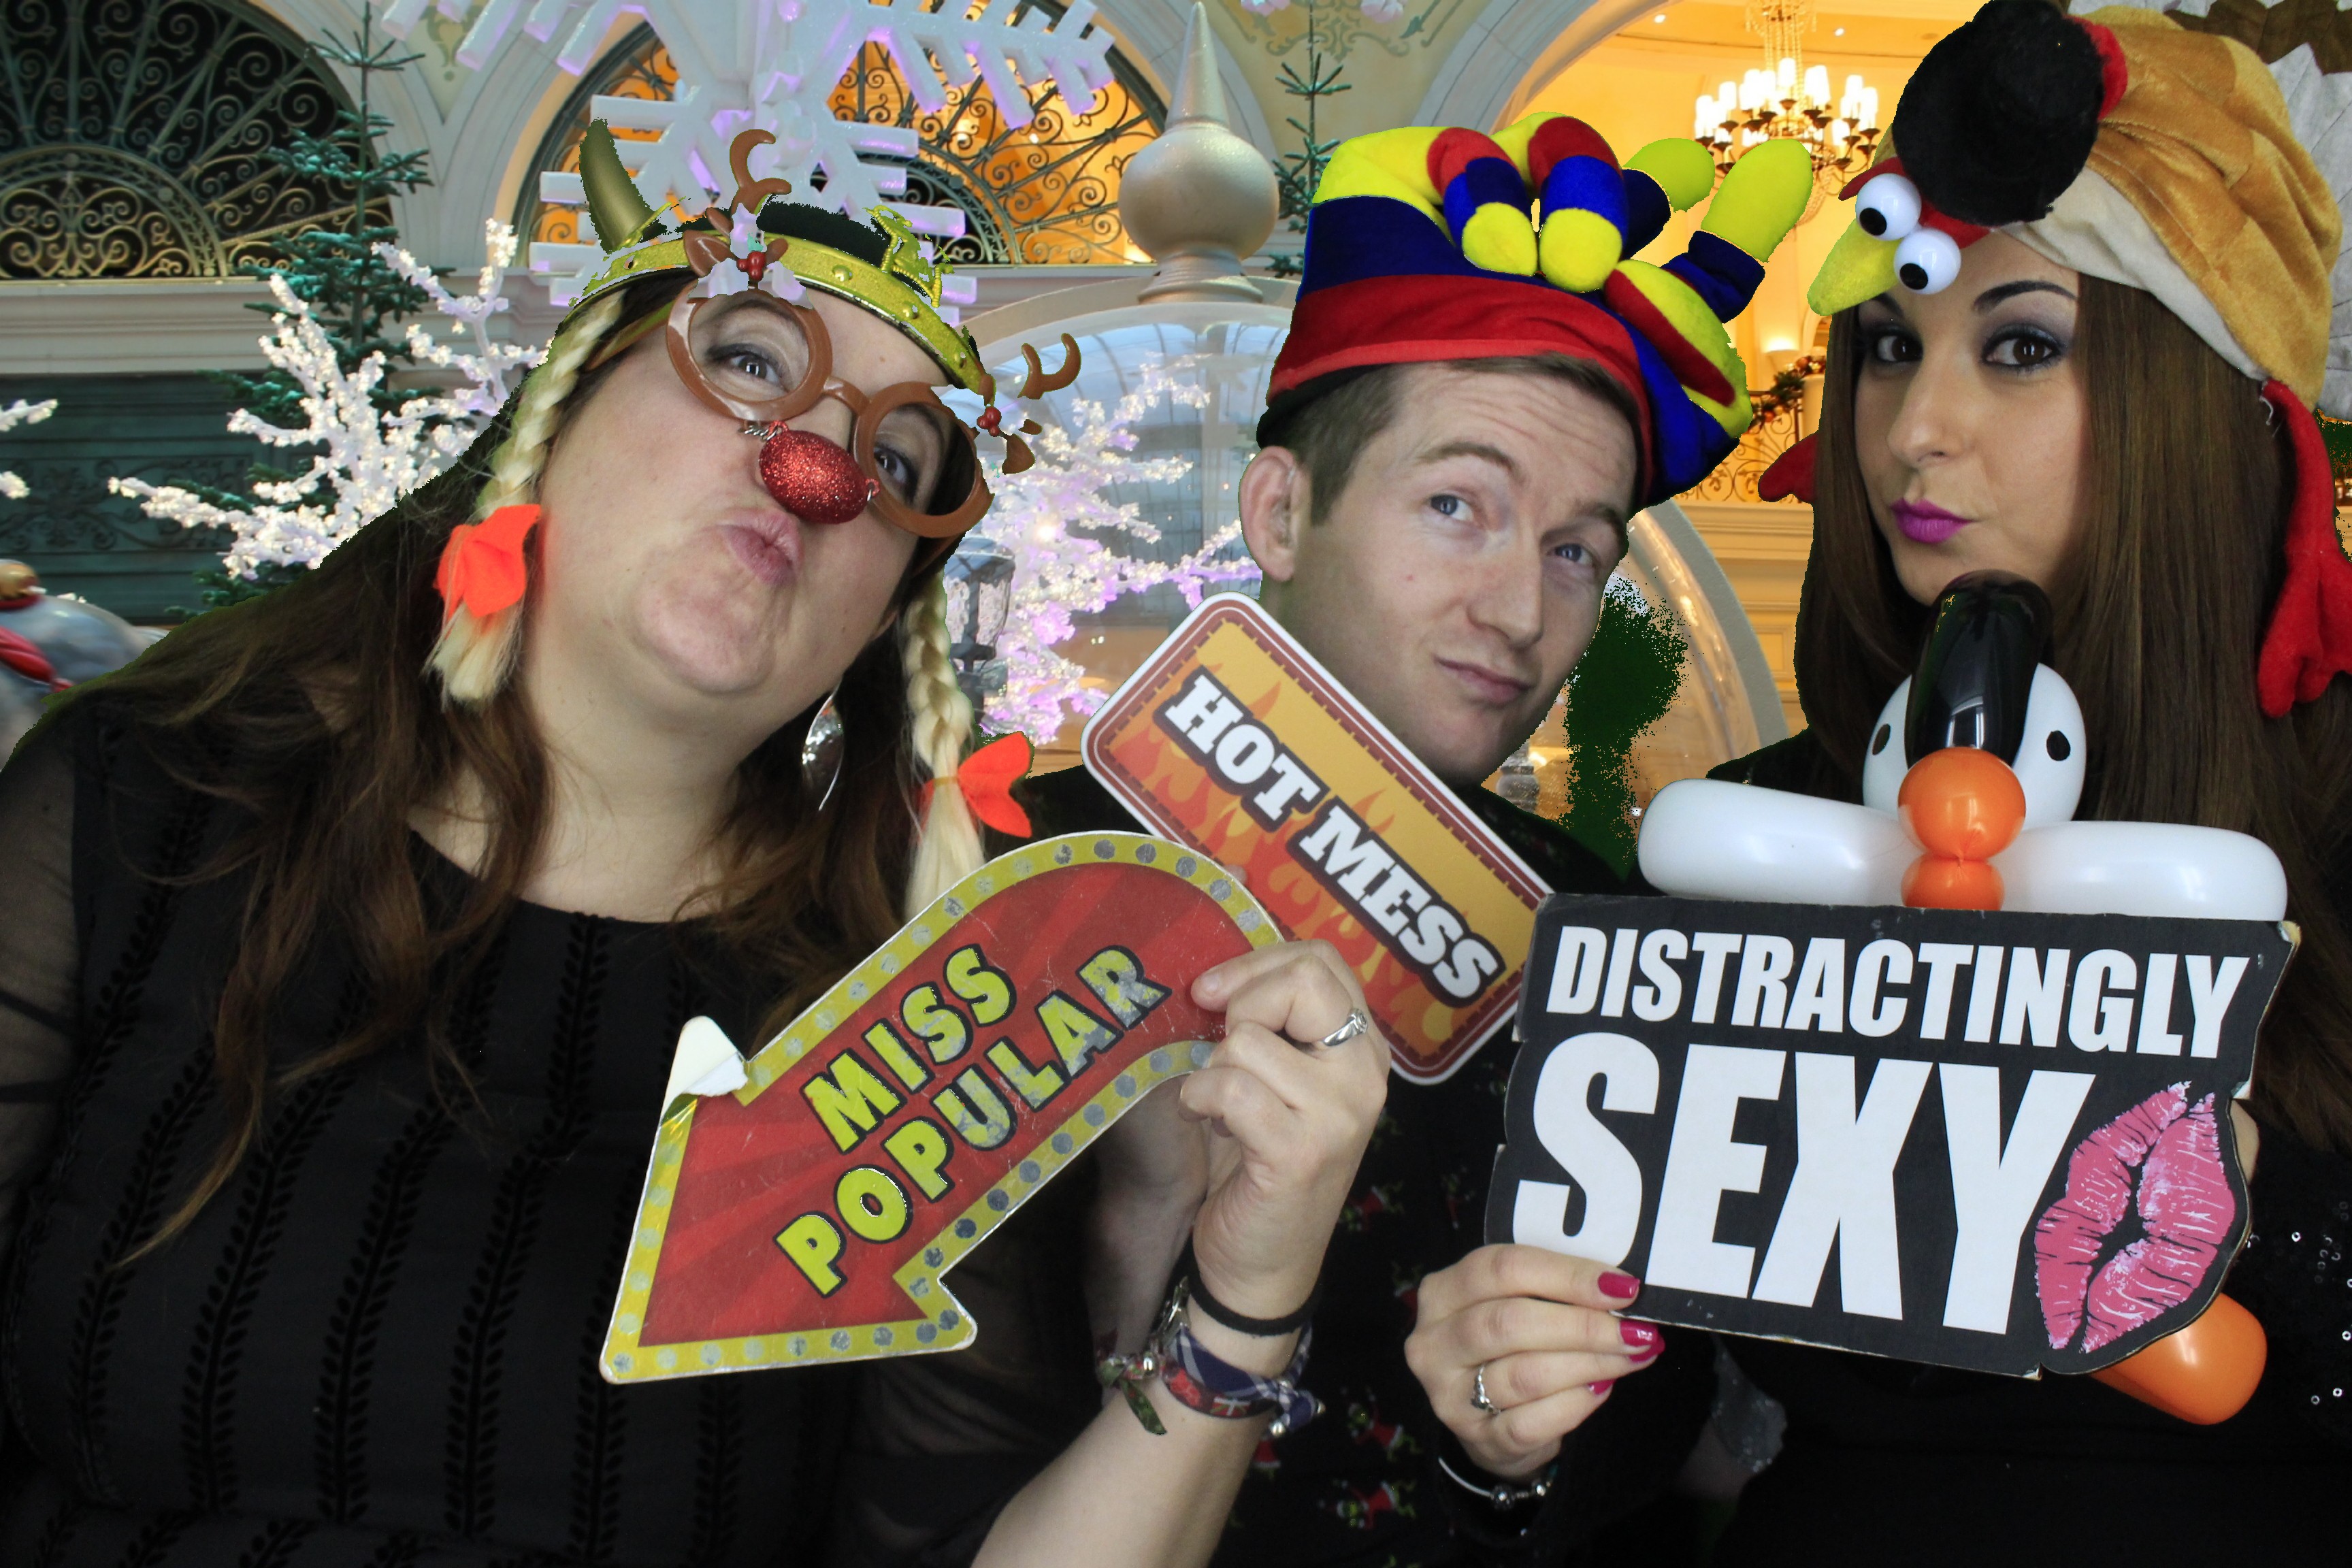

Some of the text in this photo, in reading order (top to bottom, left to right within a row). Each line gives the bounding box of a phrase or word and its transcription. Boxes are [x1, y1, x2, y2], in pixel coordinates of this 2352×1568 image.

[1160, 670, 1501, 1002] HOT MESS
[774, 947, 1171, 1296] POPULAR
[802, 945, 1015, 1153] MISS
[1546, 925, 2251, 1059] DISTRACTINGLY
[1512, 1032, 2096, 1335] SEXY
